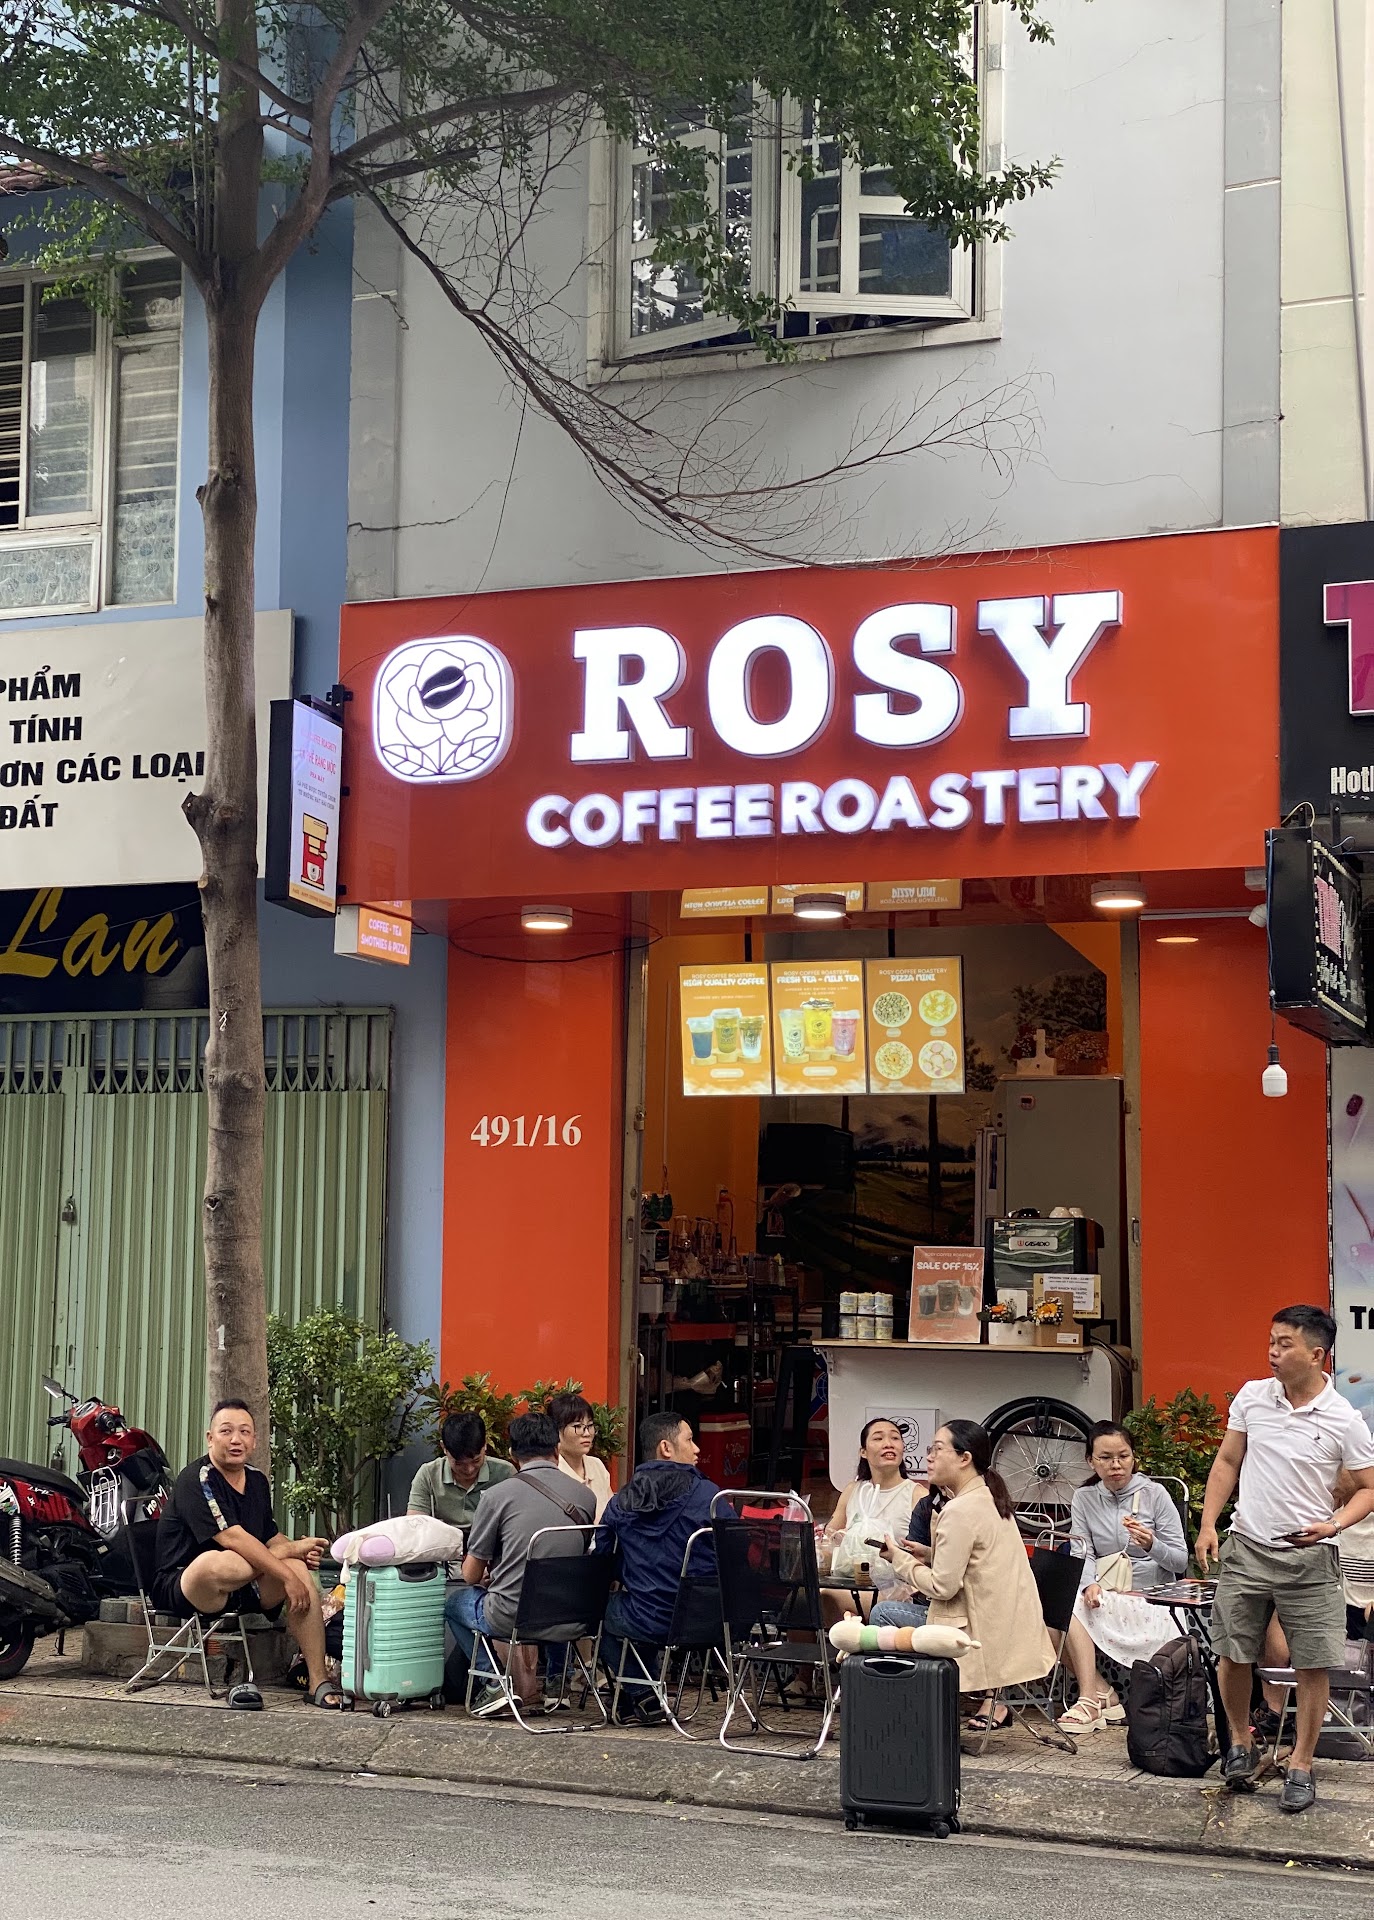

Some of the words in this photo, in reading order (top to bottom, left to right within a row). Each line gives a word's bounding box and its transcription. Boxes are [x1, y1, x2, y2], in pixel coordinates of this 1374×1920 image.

[569, 589, 1123, 765] ROSY
[9, 713, 82, 744] TÍNH
[57, 752, 121, 783] CÁC
[132, 751, 205, 782] LOẠI
[0, 794, 58, 829] ĐẤT
[0, 887, 178, 978] Lan
[368, 918, 389, 933] COFFEE
[392, 924, 402, 937] TEA
[392, 941, 408, 956] PIZZA
[683, 979, 702, 987] HIGH
[704, 978, 736, 986] QUALITY
[737, 977, 765, 986] COFFEE
[776, 976, 801, 984] FRESH
[801, 975, 817, 983] TEA
[844, 974, 860, 983] TEA
[890, 974, 914, 982] PIZZA
[470, 1114, 582, 1147] 491/16
[916, 1261, 941, 1270] SALE
[942, 1262, 961, 1271] OFF
[962, 1262, 979, 1271] 15%
[904, 1455, 923, 1470] SY
